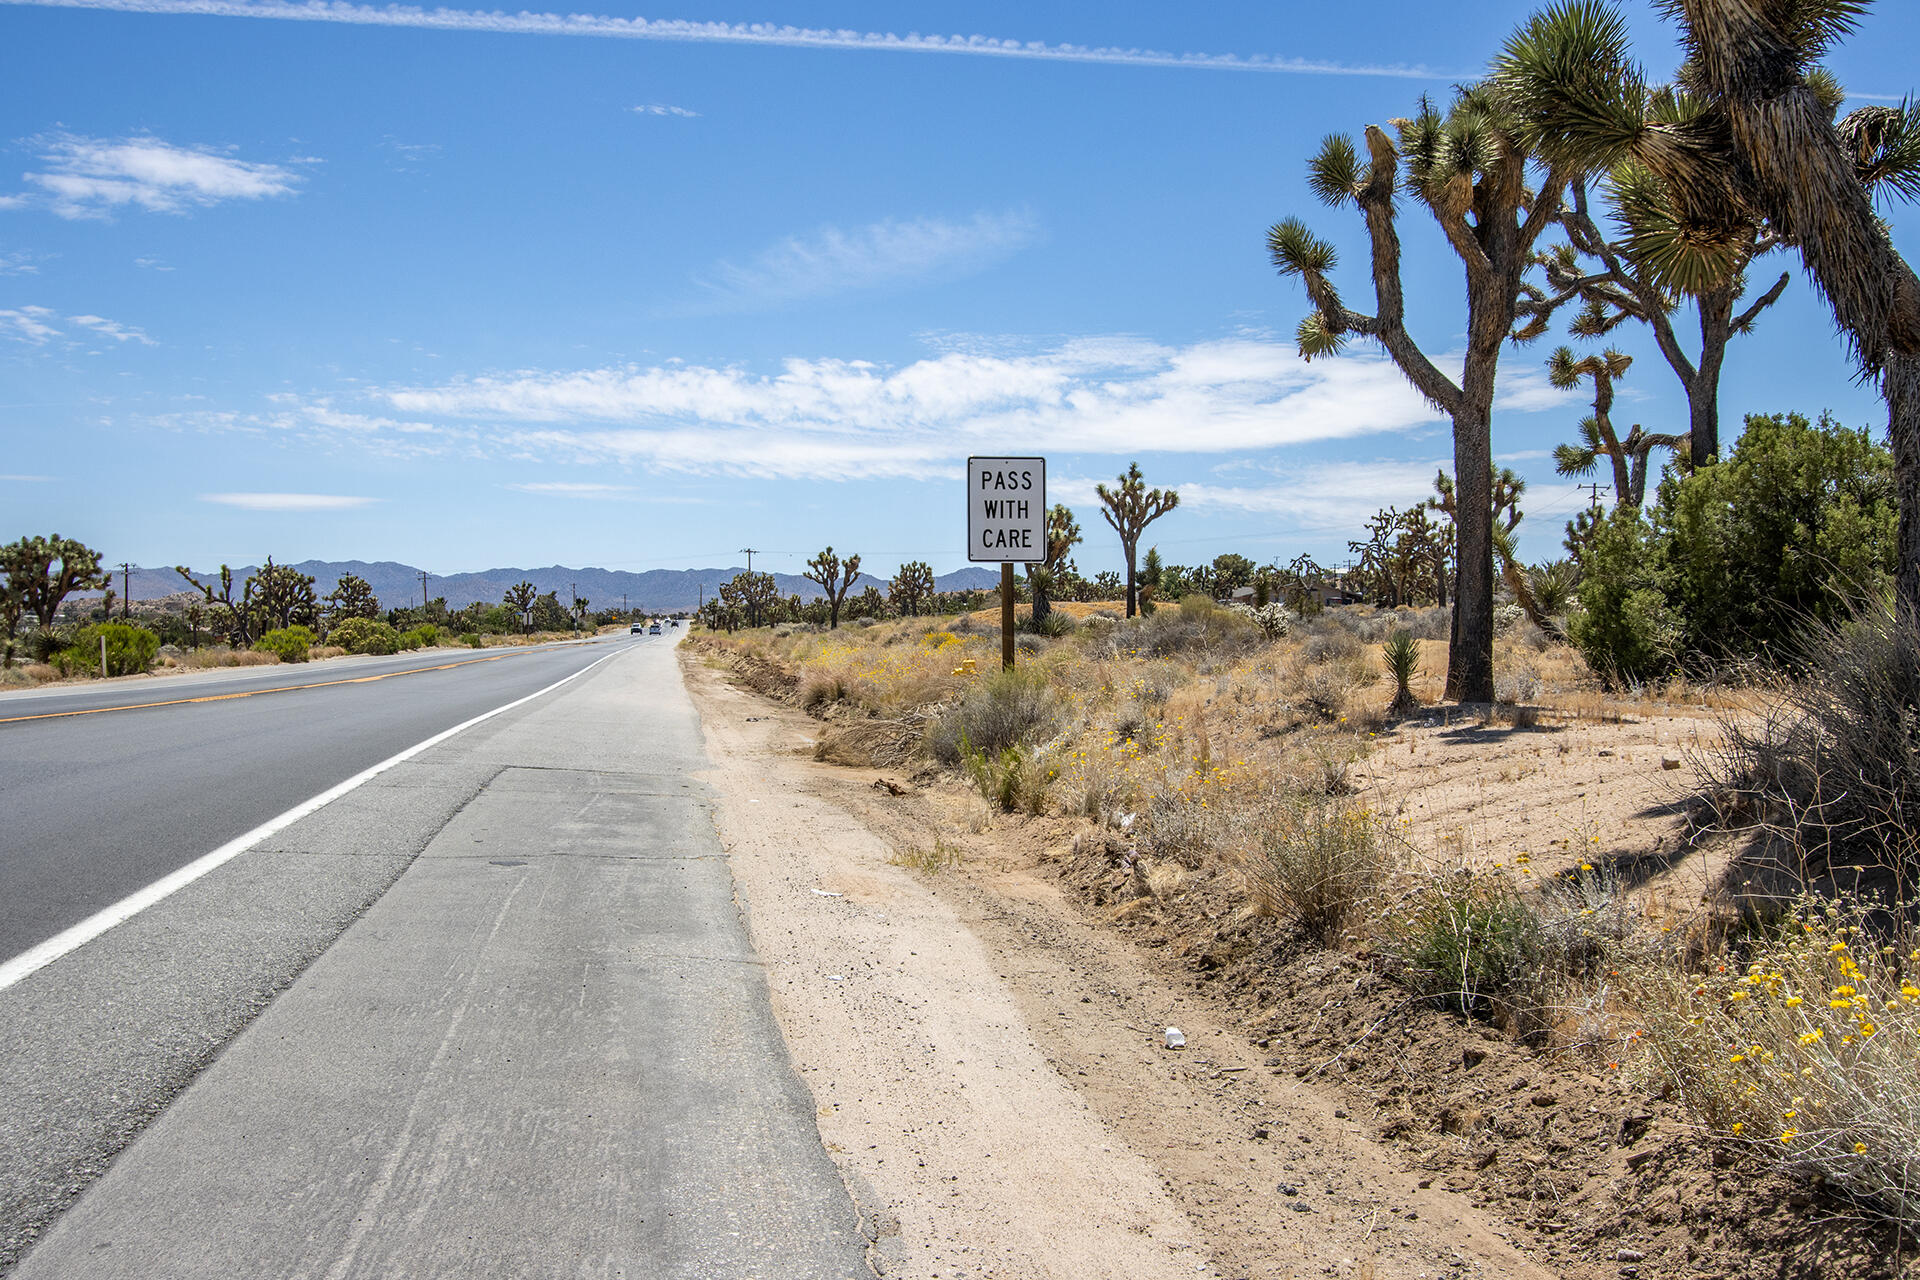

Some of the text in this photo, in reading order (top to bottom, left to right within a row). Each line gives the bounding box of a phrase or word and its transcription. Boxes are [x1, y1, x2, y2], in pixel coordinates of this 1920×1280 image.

[981, 471, 1032, 490] PASS
[984, 500, 1029, 519] WITH
[982, 529, 1032, 548] CARE
